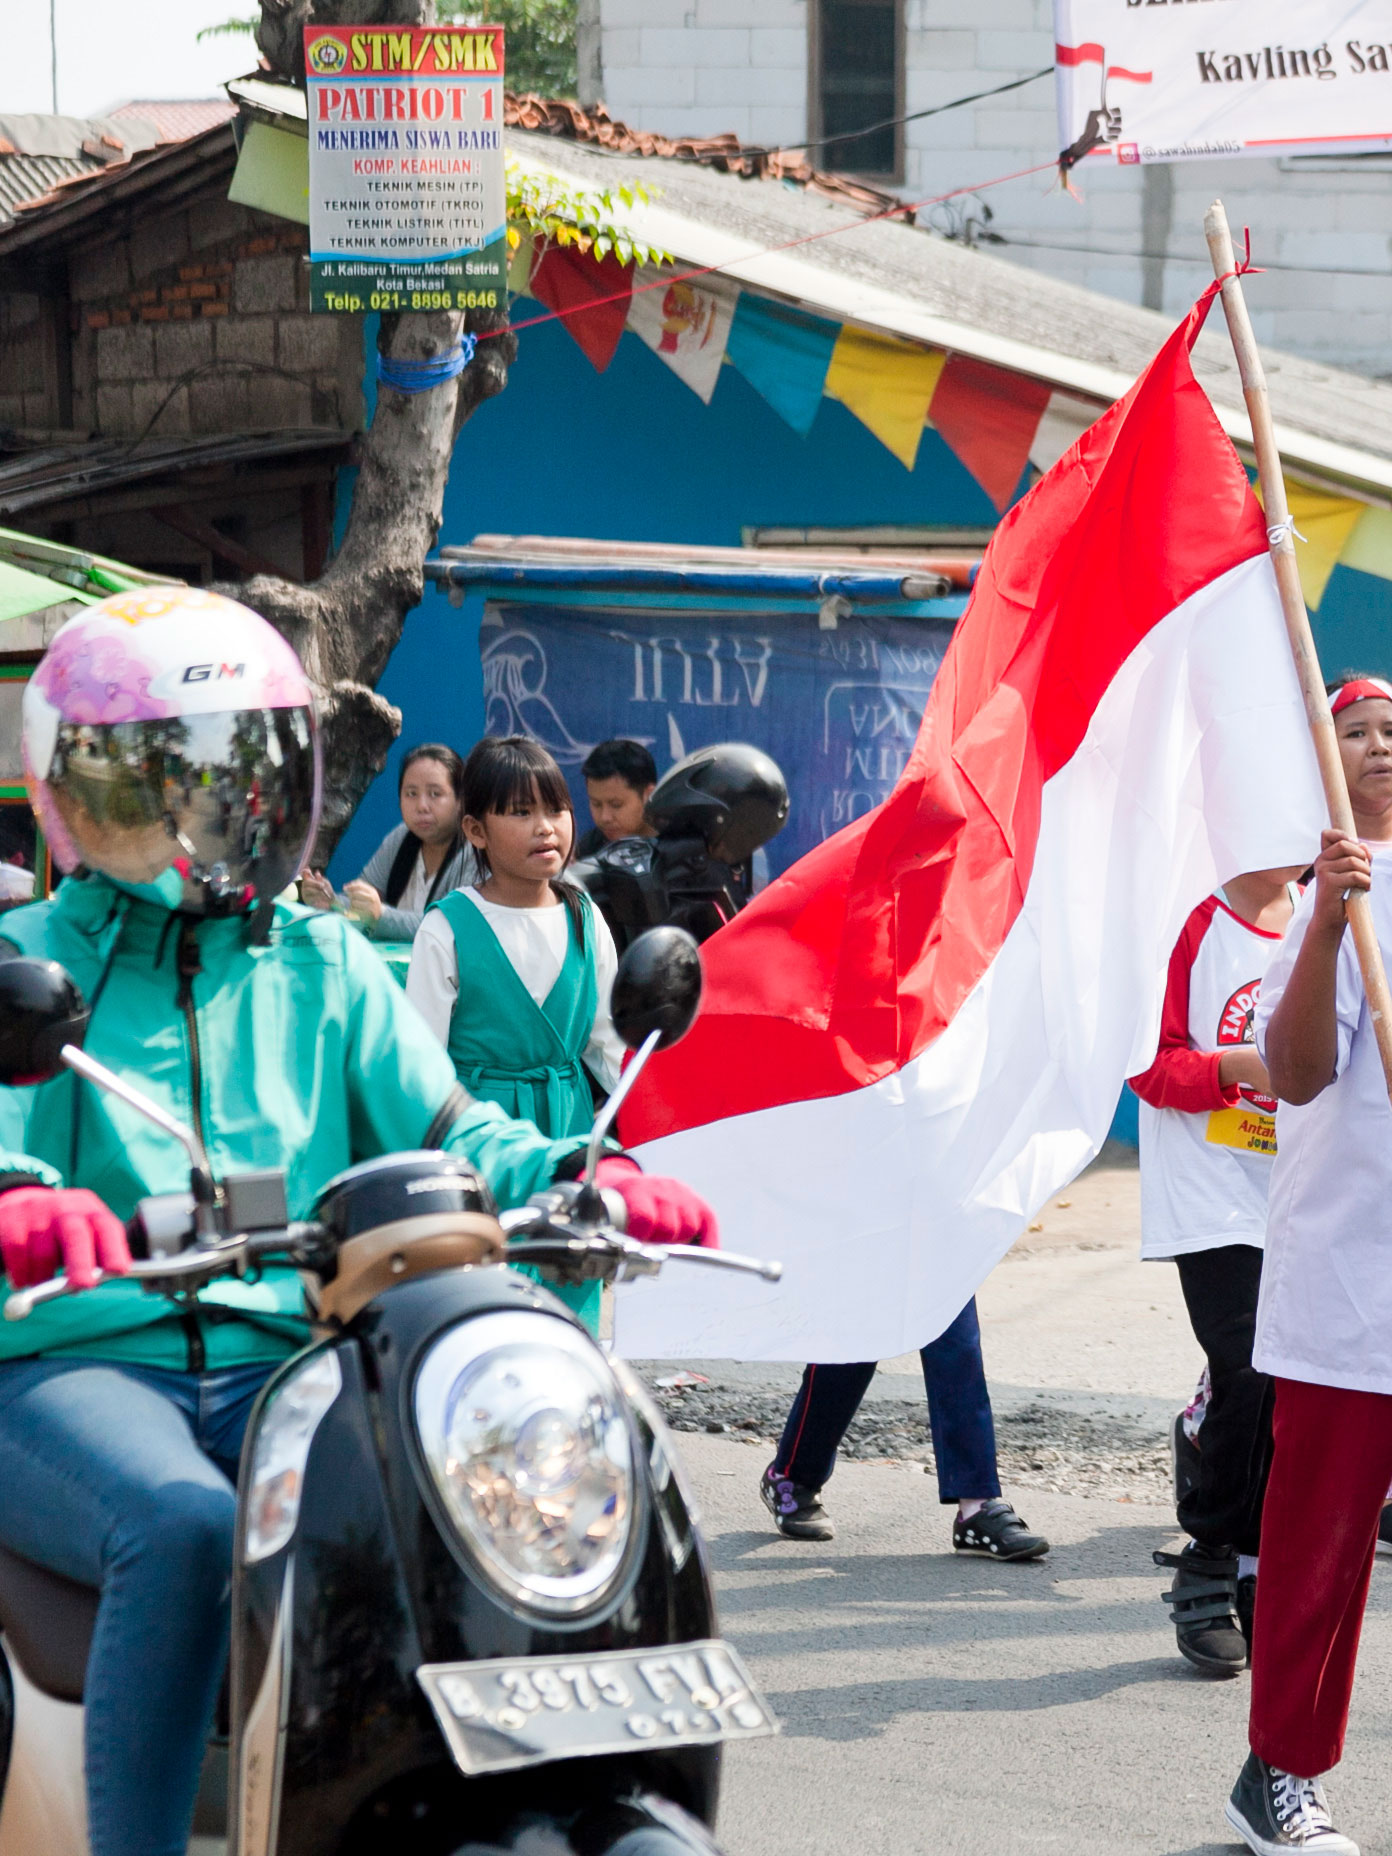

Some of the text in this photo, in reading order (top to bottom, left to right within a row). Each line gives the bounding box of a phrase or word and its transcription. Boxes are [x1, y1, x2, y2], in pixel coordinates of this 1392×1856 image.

[351, 32, 498, 71] STM/SMK
[1196, 43, 1337, 83] Kavling
[317, 87, 495, 121] PATRIOT 1
[318, 130, 501, 150] MENERIMA SISWA BARU
[354, 159, 395, 174] KOMP.
[400, 159, 471, 174] KEAHLIAN
[367, 182, 483, 193] TEKNIK MESIN (TP)
[325, 201, 484, 213] TEKNIK OTOMOTIF (TKRO)
[347, 218, 484, 230] TEKNIK LISTRIK (TITL)
[330, 237, 486, 250] TEKNIK KOMPUTER (TKJ)
[321, 265, 335, 276] Jl.
[338, 263, 386, 276] Kalibaru
[465, 263, 499, 276] Satria
[376, 279, 445, 291] Kota Bekasi
[324, 292, 365, 312] Telp.
[411, 291, 451, 309] 8896
[457, 290, 497, 309] 5646
[182, 663, 245, 683] GM
